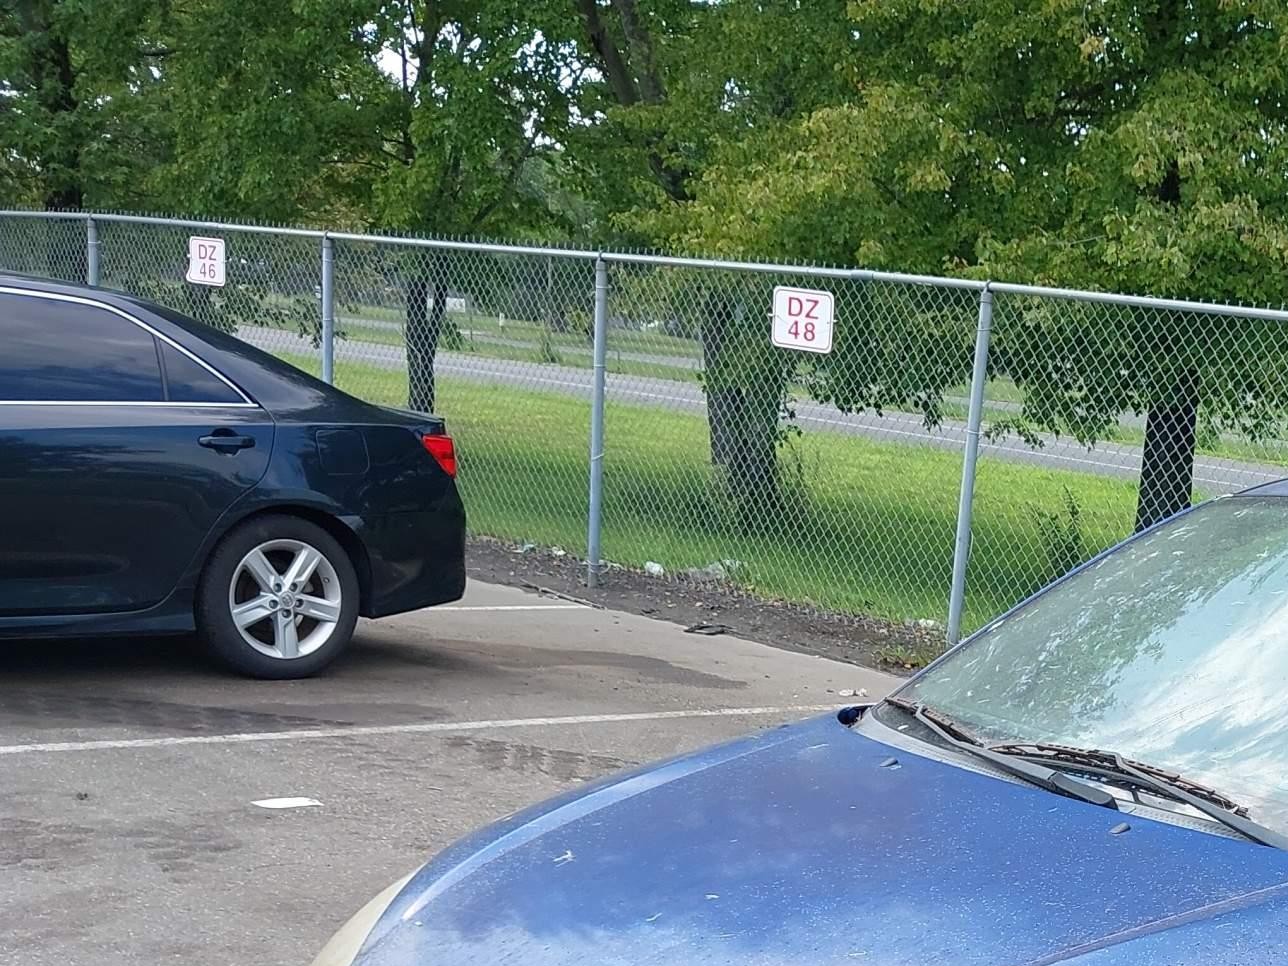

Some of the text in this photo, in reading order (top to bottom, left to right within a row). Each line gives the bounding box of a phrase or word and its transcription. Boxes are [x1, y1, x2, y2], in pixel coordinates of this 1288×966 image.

[198, 243, 217, 261] DZ
[199, 262, 216, 279] 46
[788, 296, 819, 320] DZ
[787, 320, 816, 341] 48
